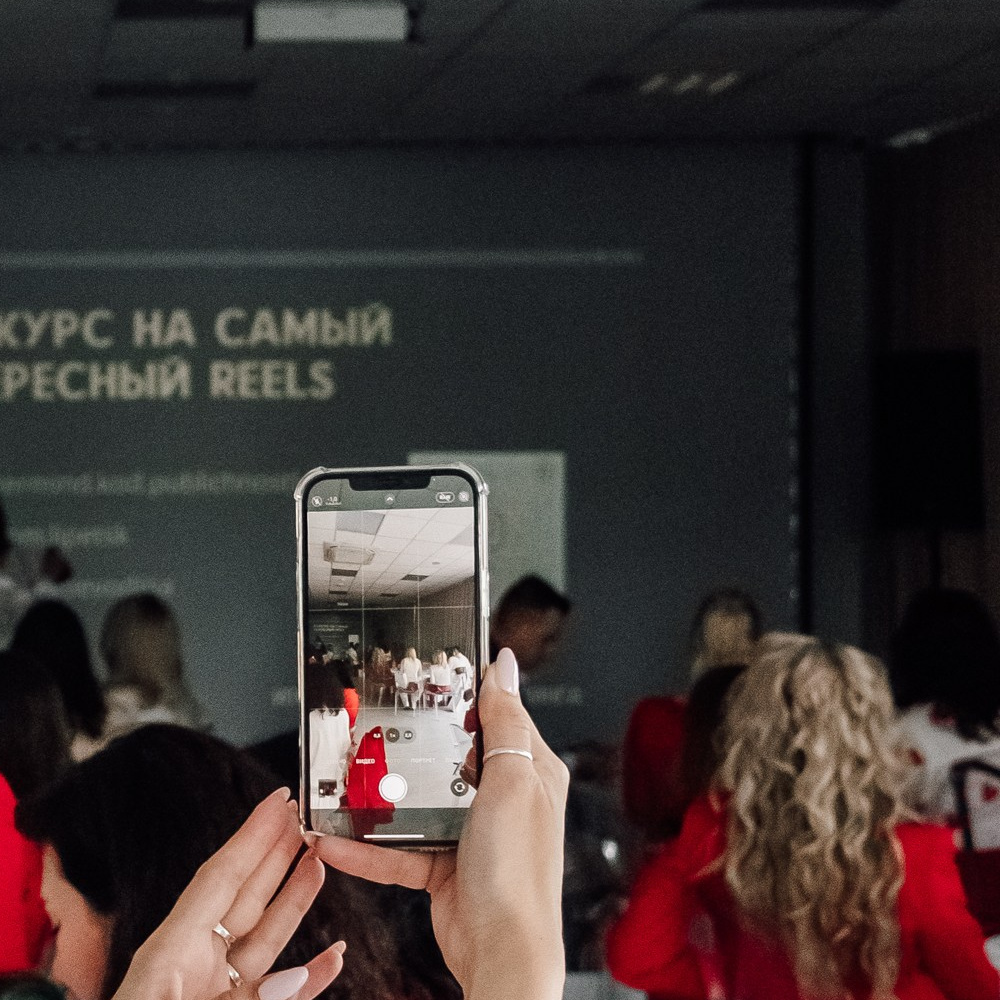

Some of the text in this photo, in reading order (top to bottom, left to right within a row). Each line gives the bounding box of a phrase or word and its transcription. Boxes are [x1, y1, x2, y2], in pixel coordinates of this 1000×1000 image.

[132, 309, 196, 348] НА
[214, 302, 392, 348] САМЫЙ
[209, 360, 337, 401] REELS
